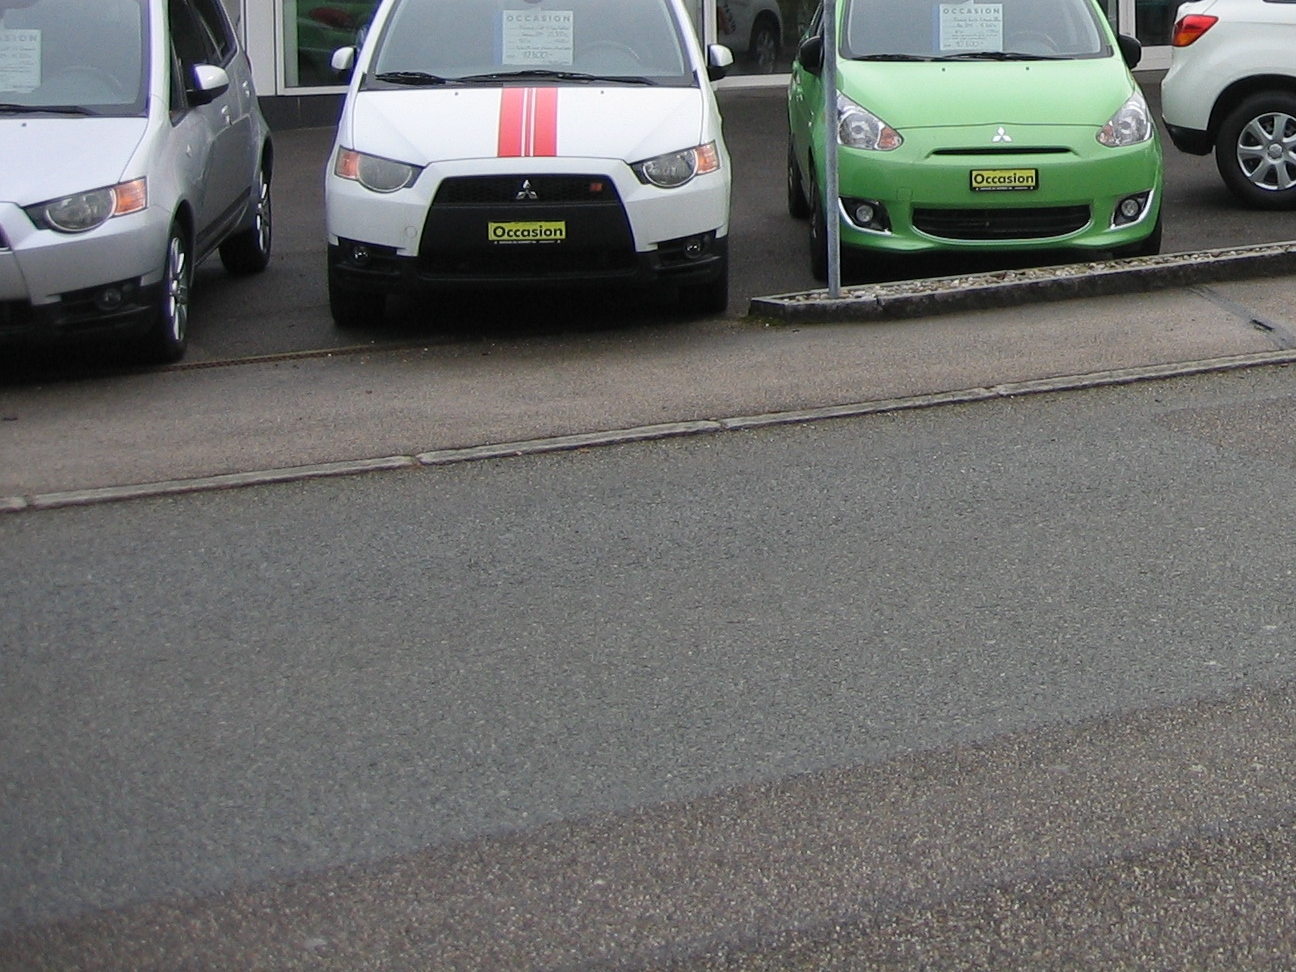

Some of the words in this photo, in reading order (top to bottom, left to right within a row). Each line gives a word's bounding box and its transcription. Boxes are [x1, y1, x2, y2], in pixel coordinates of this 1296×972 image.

[942, 8, 1001, 16] OCCASION
[506, 15, 571, 23] OCCASION
[0, 34, 37, 42] SION
[973, 172, 1034, 185] Occasion
[493, 224, 563, 239] Occasion
